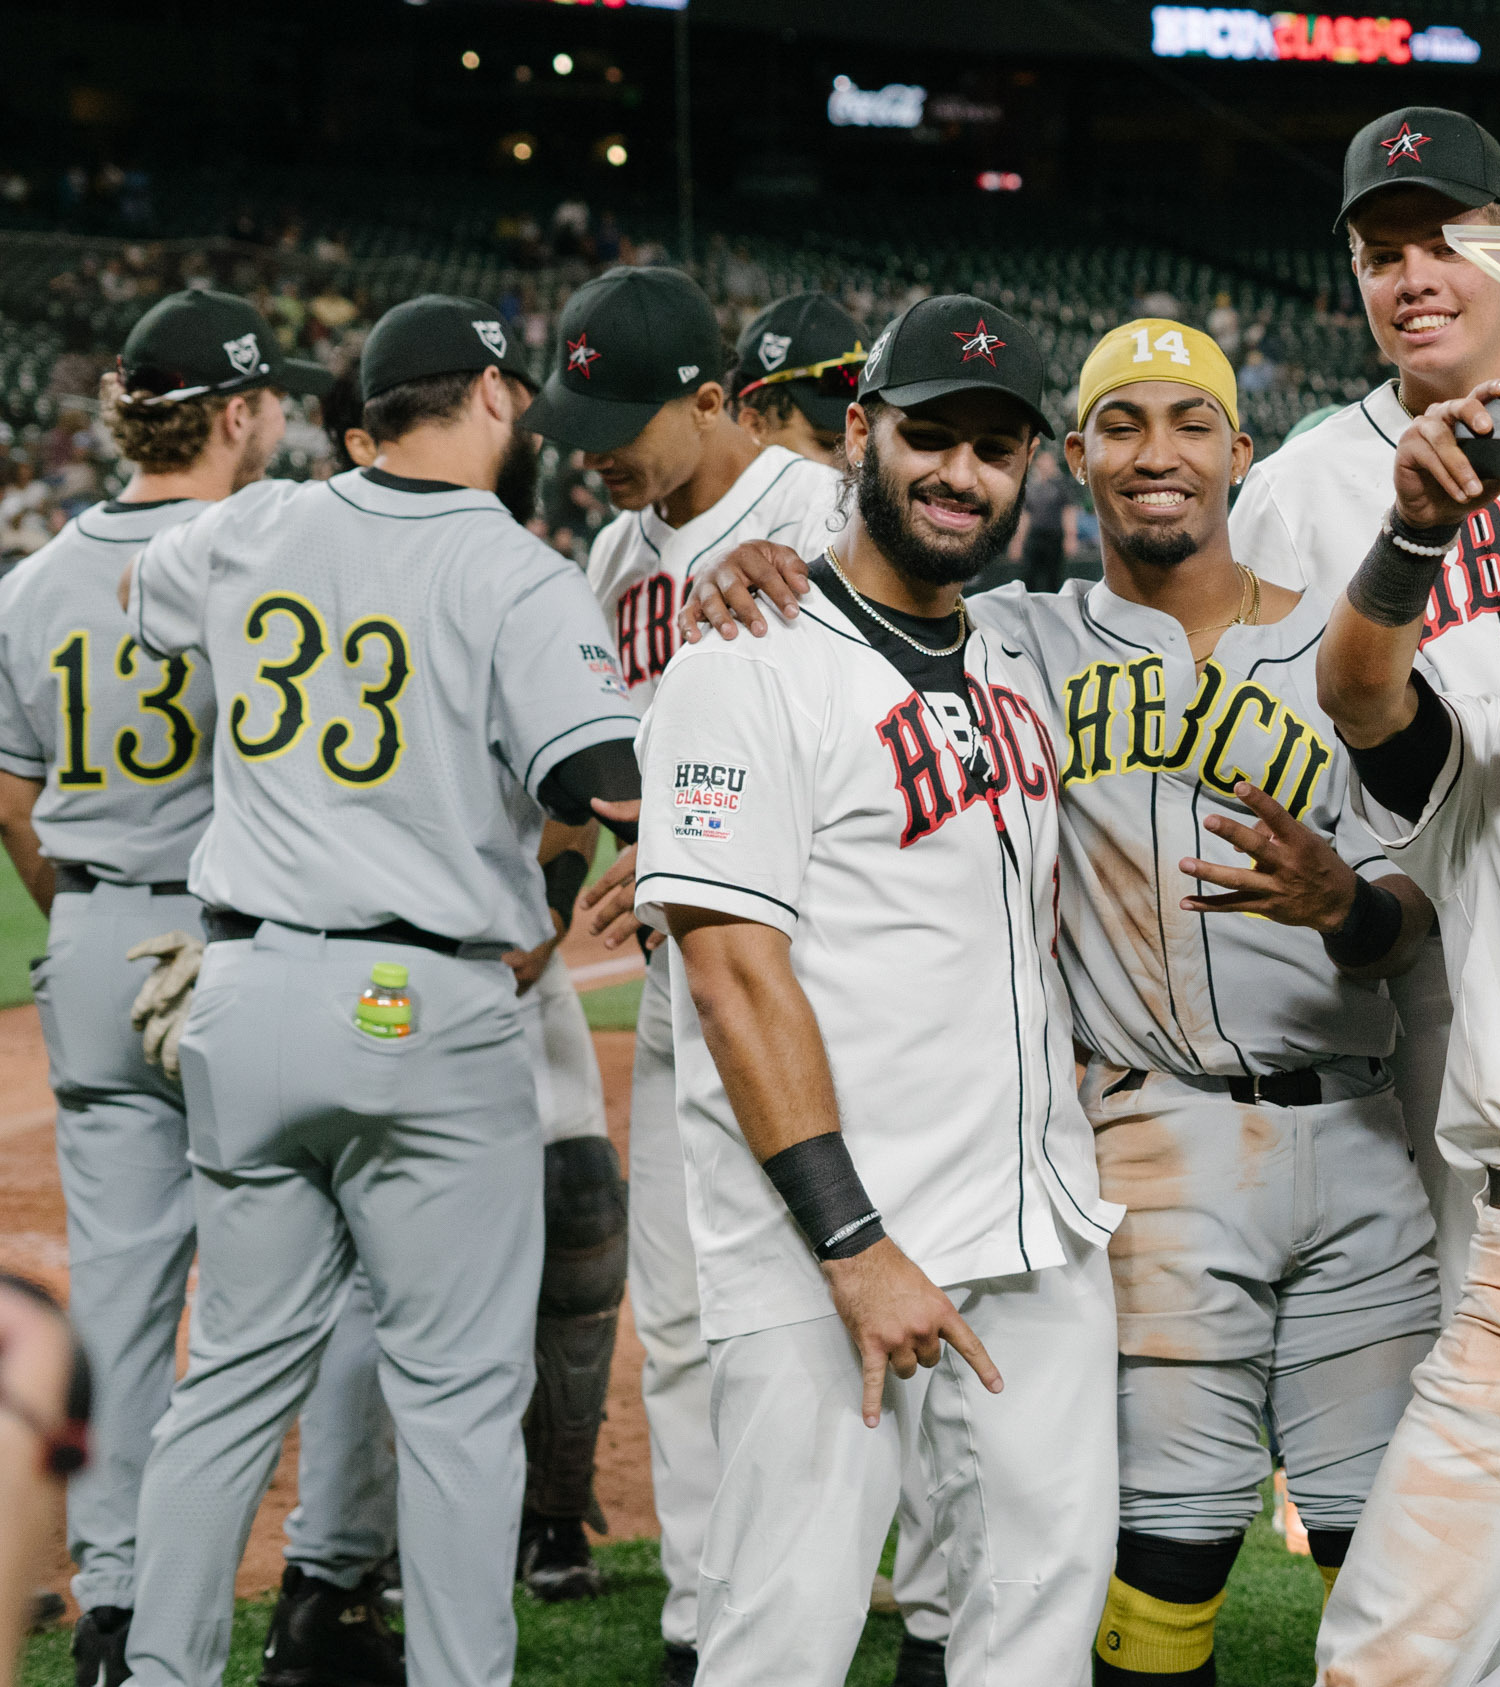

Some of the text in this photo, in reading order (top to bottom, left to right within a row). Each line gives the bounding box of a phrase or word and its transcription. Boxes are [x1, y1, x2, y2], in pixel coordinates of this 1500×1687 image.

[1131, 328, 1191, 366] 14
[50, 631, 203, 785] 13
[229, 589, 417, 790] 33
[675, 764, 746, 792] HBCU
